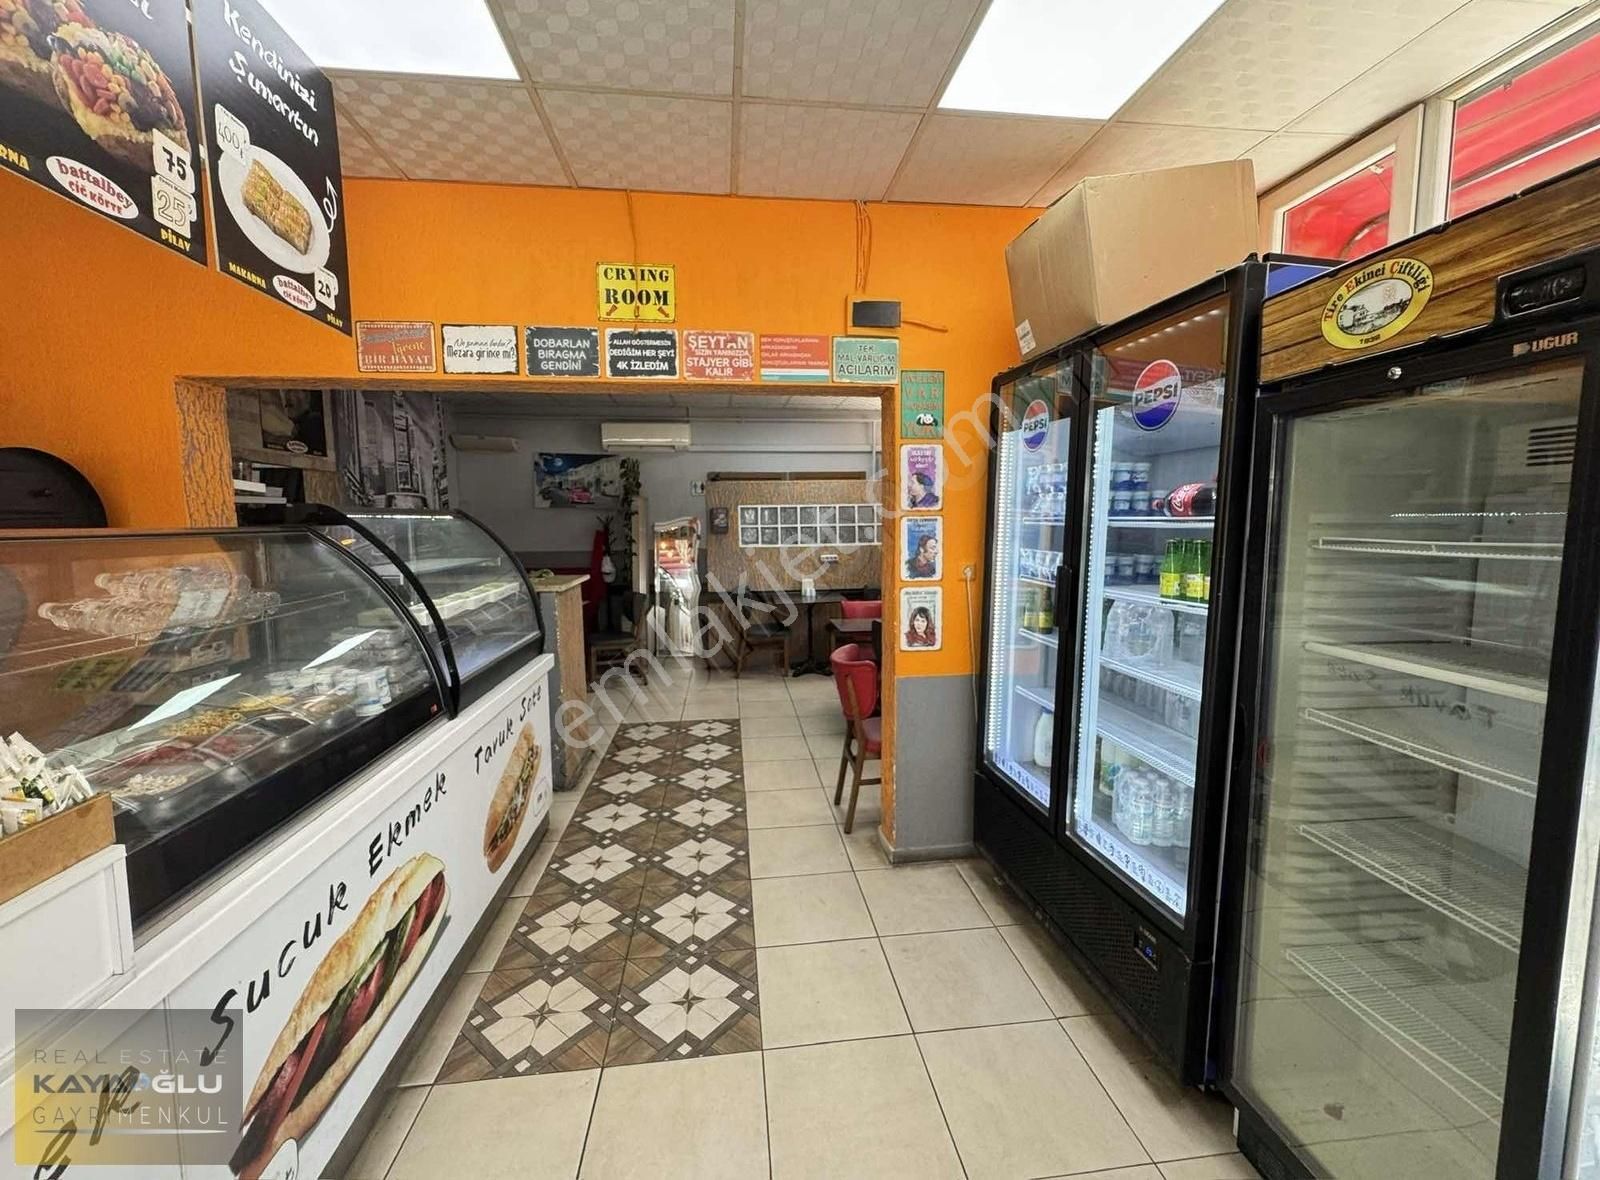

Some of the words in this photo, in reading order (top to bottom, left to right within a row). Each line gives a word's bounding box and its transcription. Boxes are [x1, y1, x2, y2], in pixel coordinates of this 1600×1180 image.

[161, 146, 188, 181] 75
[157, 188, 188, 228] 25
[229, 262, 267, 290] MAKARNA
[604, 268, 669, 283] CRYING
[318, 279, 333, 299] 20
[1324, 294, 1344, 322] Tire
[1344, 266, 1386, 296] Ekinci
[1389, 262, 1432, 294] Çiftliği
[605, 288, 670, 306] ROOM
[534, 338, 590, 349] DOBARLAN
[859, 344, 874, 353] TEK
[447, 345, 474, 359] Mezara
[610, 348, 642, 357] DEDİĞİM
[643, 349, 656, 357] HER
[541, 359, 582, 371] GENDİNİ
[617, 360, 629, 370] 4K
[630, 359, 669, 371] İZLEDİM
[687, 357, 730, 368] STAJYER
[705, 368, 733, 377] KALIR
[838, 365, 895, 376] ACILARIM
[1135, 384, 1179, 407] PEPSI
[1024, 418, 1048, 433] PEPSI
[475, 716, 514, 775] Tavuk
[520, 685, 543, 722] Sote
[199, 882, 349, 1067] Sucuk
[367, 771, 448, 877] Ekmek
